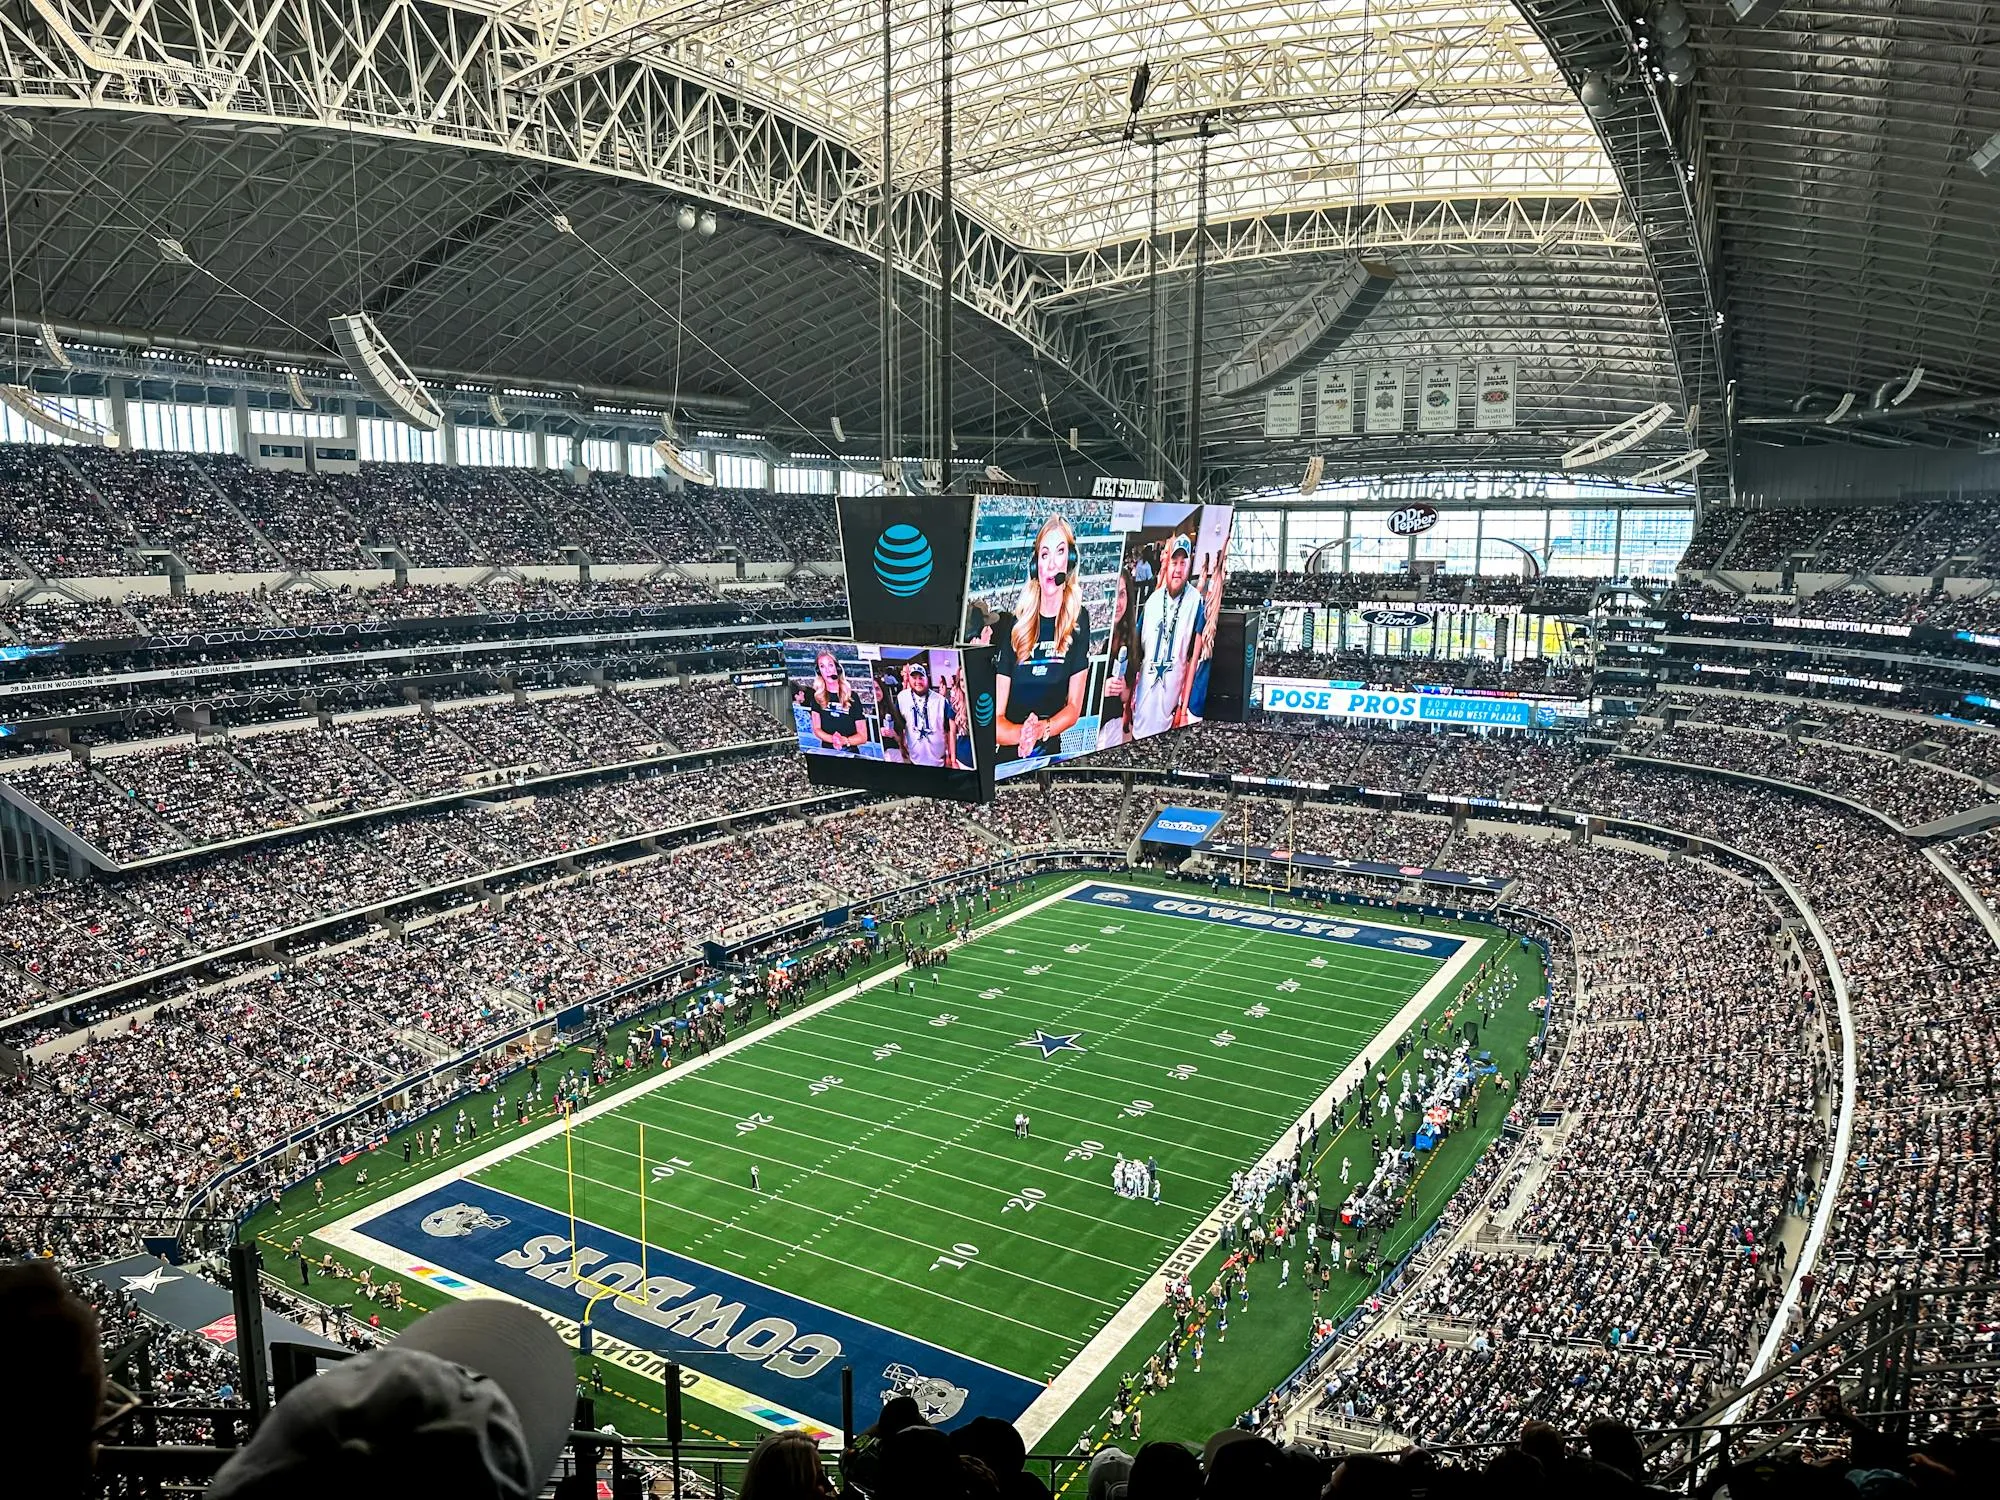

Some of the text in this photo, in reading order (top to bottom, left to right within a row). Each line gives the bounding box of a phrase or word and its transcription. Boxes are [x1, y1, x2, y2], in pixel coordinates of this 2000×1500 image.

[1091, 477, 1164, 500] AT&T STADIUM
[1390, 511, 1436, 532] Pepper
[1406, 508, 1424, 521] Dr
[1358, 601, 1523, 615] MAKE YOUR CRYPTO PLAY TODAY
[1374, 612, 1417, 626] Ford
[1773, 617, 1911, 637] MAKE YOUR CRYPTO PLAY TODAY
[180, 667, 210, 676] CHARLES
[210, 664, 230, 672] HALEY
[1786, 671, 1808, 681] MAKE
[1829, 676, 1859, 687] CRYPTO
[21, 682, 53, 692] DARREN
[55, 679, 93, 688] WOODSON
[1268, 689, 1417, 716] POSE PROS
[1427, 700, 1518, 712] NOW LOCATED IN
[1425, 708, 1522, 723] EAST AND WEST PLAZAS
[1267, 778, 1291, 787] CRYPTO
[1468, 798, 1498, 808] CRYPTO
[1153, 899, 1361, 938] COWBOYS
[928, 1013, 960, 1027] 50
[1209, 1032, 1236, 1048] 40
[872, 1042, 903, 1057] 40
[1166, 1064, 1198, 1081] 50
[808, 1075, 844, 1093] 30
[1123, 1099, 1154, 1118] 40
[735, 1112, 775, 1132] 20
[1068, 1140, 1105, 1161] 30
[651, 1156, 694, 1177] 10
[1006, 1187, 1047, 1213] 20
[937, 1242, 980, 1271] 10
[1159, 1228, 1219, 1280] CANCER
[495, 1234, 842, 1379] COWBOYS
[593, 1336, 700, 1389] CUCIAL
